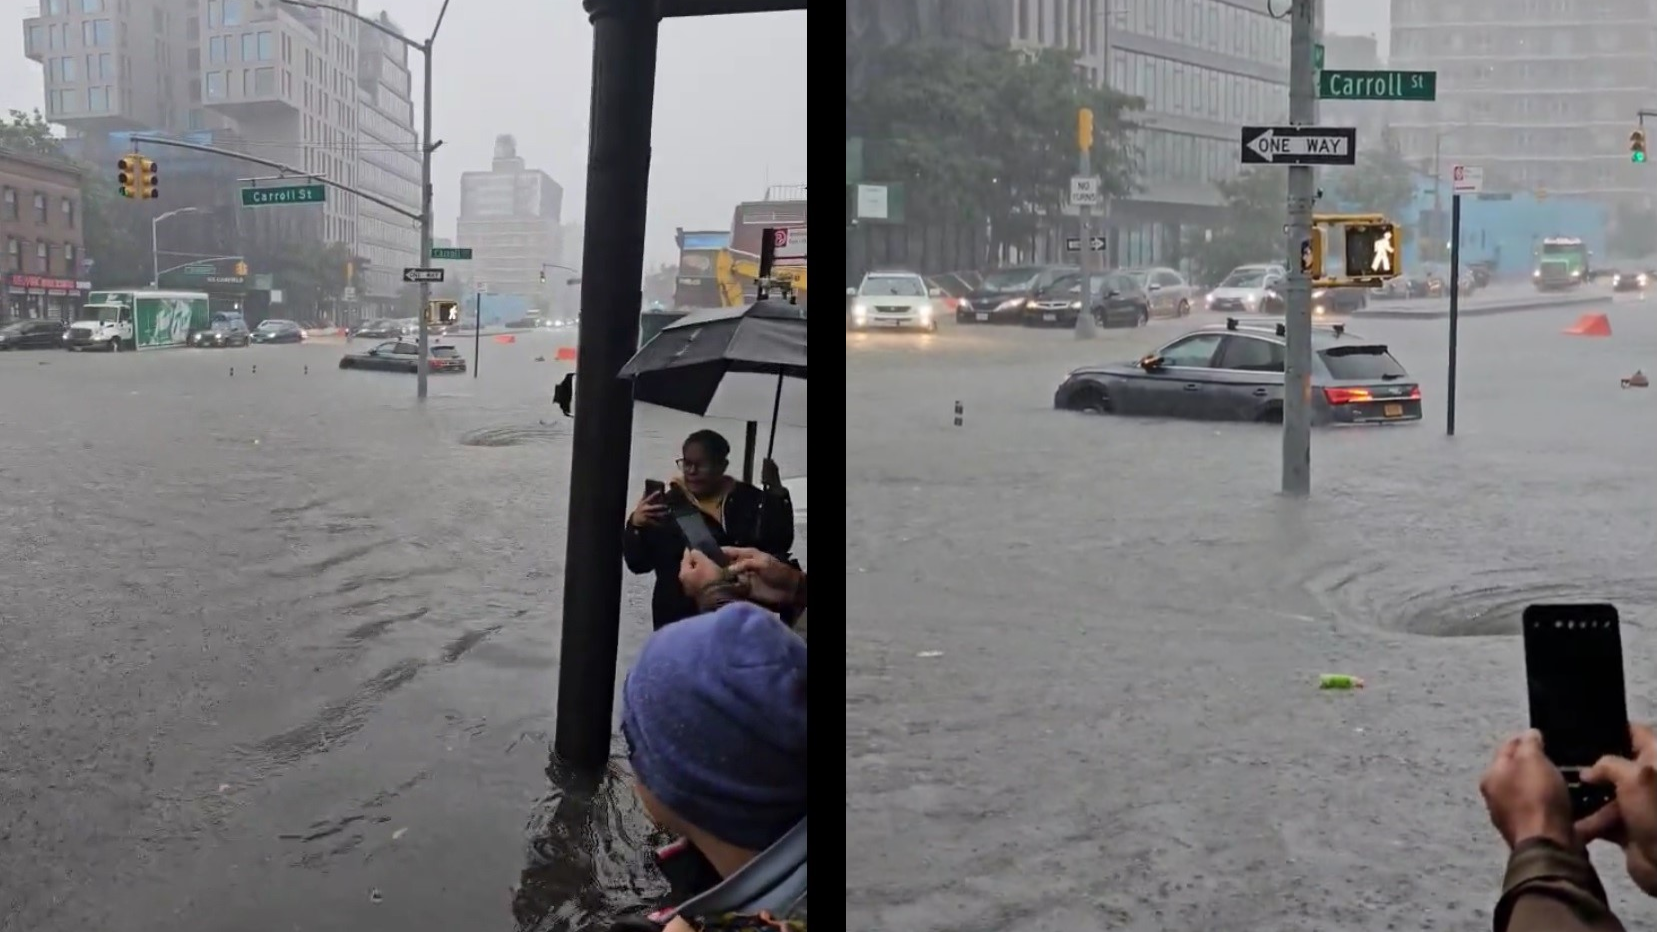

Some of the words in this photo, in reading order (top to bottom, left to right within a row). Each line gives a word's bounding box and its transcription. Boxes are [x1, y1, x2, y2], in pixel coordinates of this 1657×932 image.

[1330, 73, 1402, 96] Carroll
[1411, 74, 1424, 89] St
[1259, 138, 1290, 153] ONE
[1306, 138, 1341, 153] WAY
[1078, 182, 1090, 190] NO
[253, 190, 295, 202] Carroll
[299, 189, 312, 199] St
